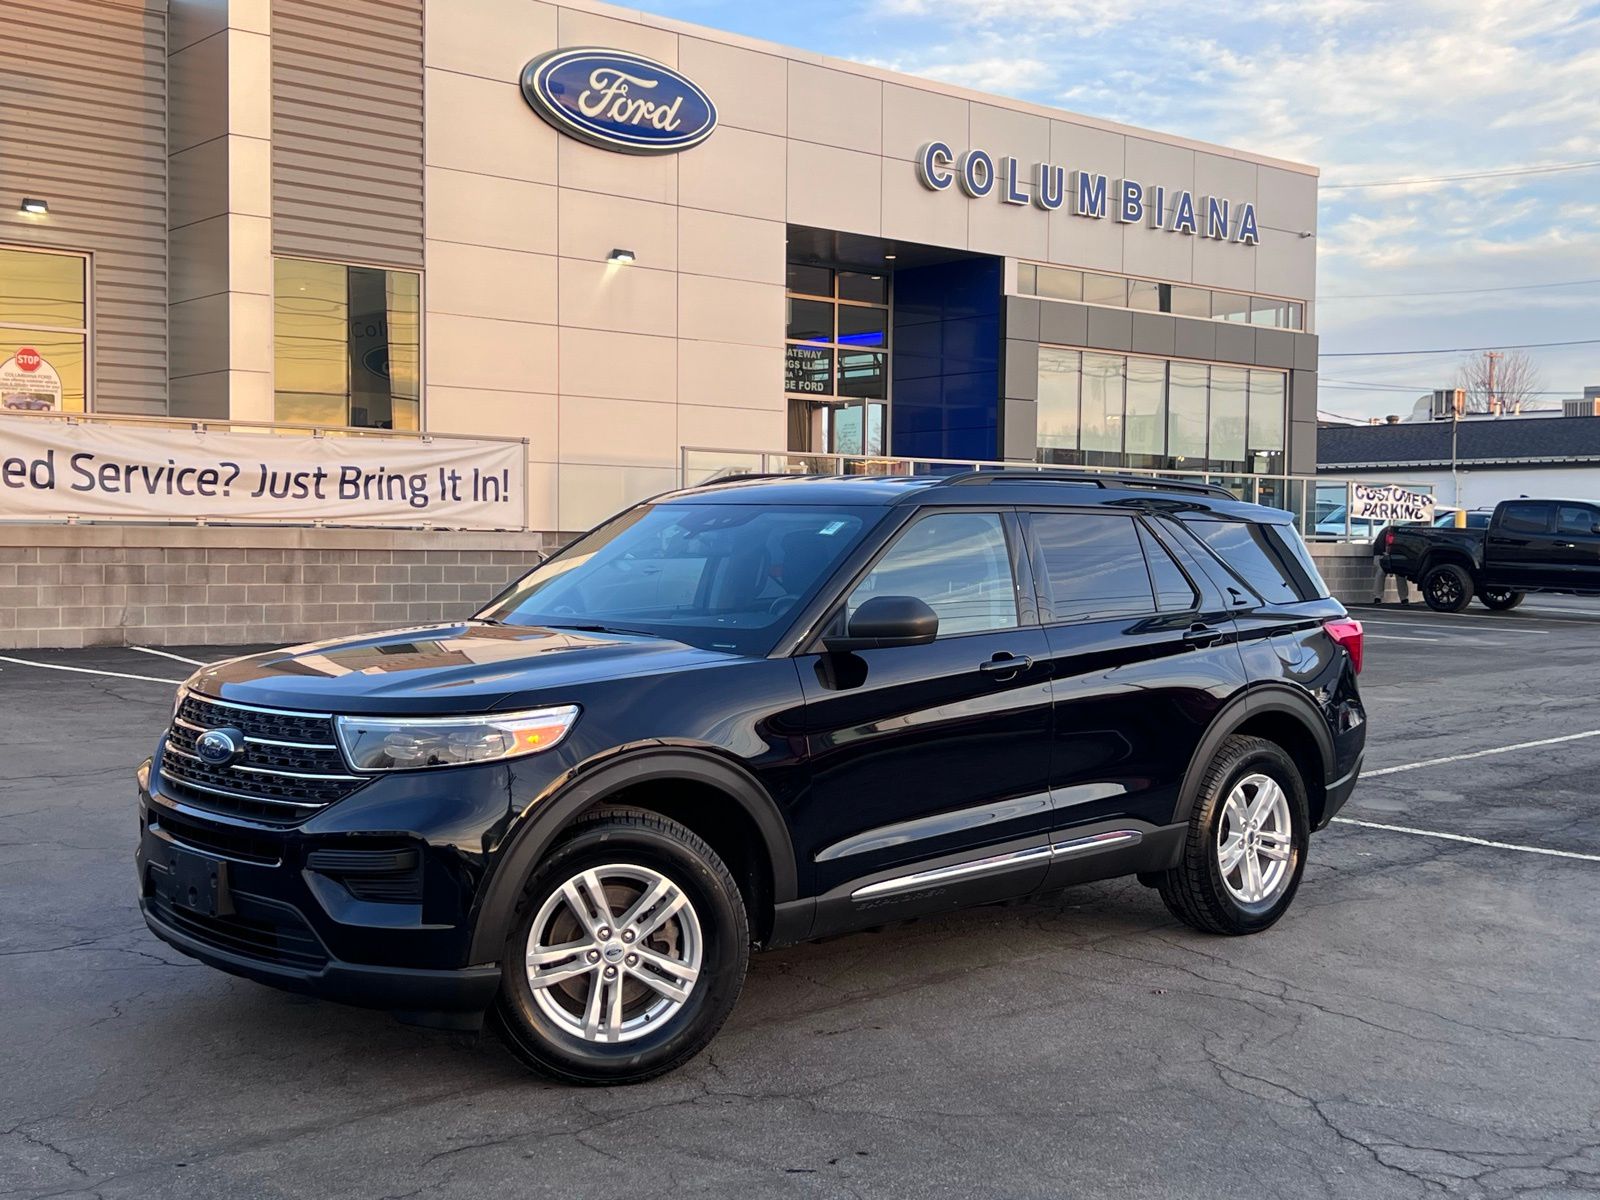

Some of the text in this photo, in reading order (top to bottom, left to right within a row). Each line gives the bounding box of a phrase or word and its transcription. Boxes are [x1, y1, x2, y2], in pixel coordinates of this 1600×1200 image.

[577, 67, 683, 132] Ford
[920, 140, 1260, 246] COLUMBIANA
[17, 354, 40, 365] STOP
[786, 347, 822, 359] ATEWAY
[798, 381, 824, 391] FORD
[2, 449, 509, 508] ed Service? Just Bring It In!
[1355, 484, 1433, 507] CUSTOMER
[1361, 502, 1424, 520] PARKING
